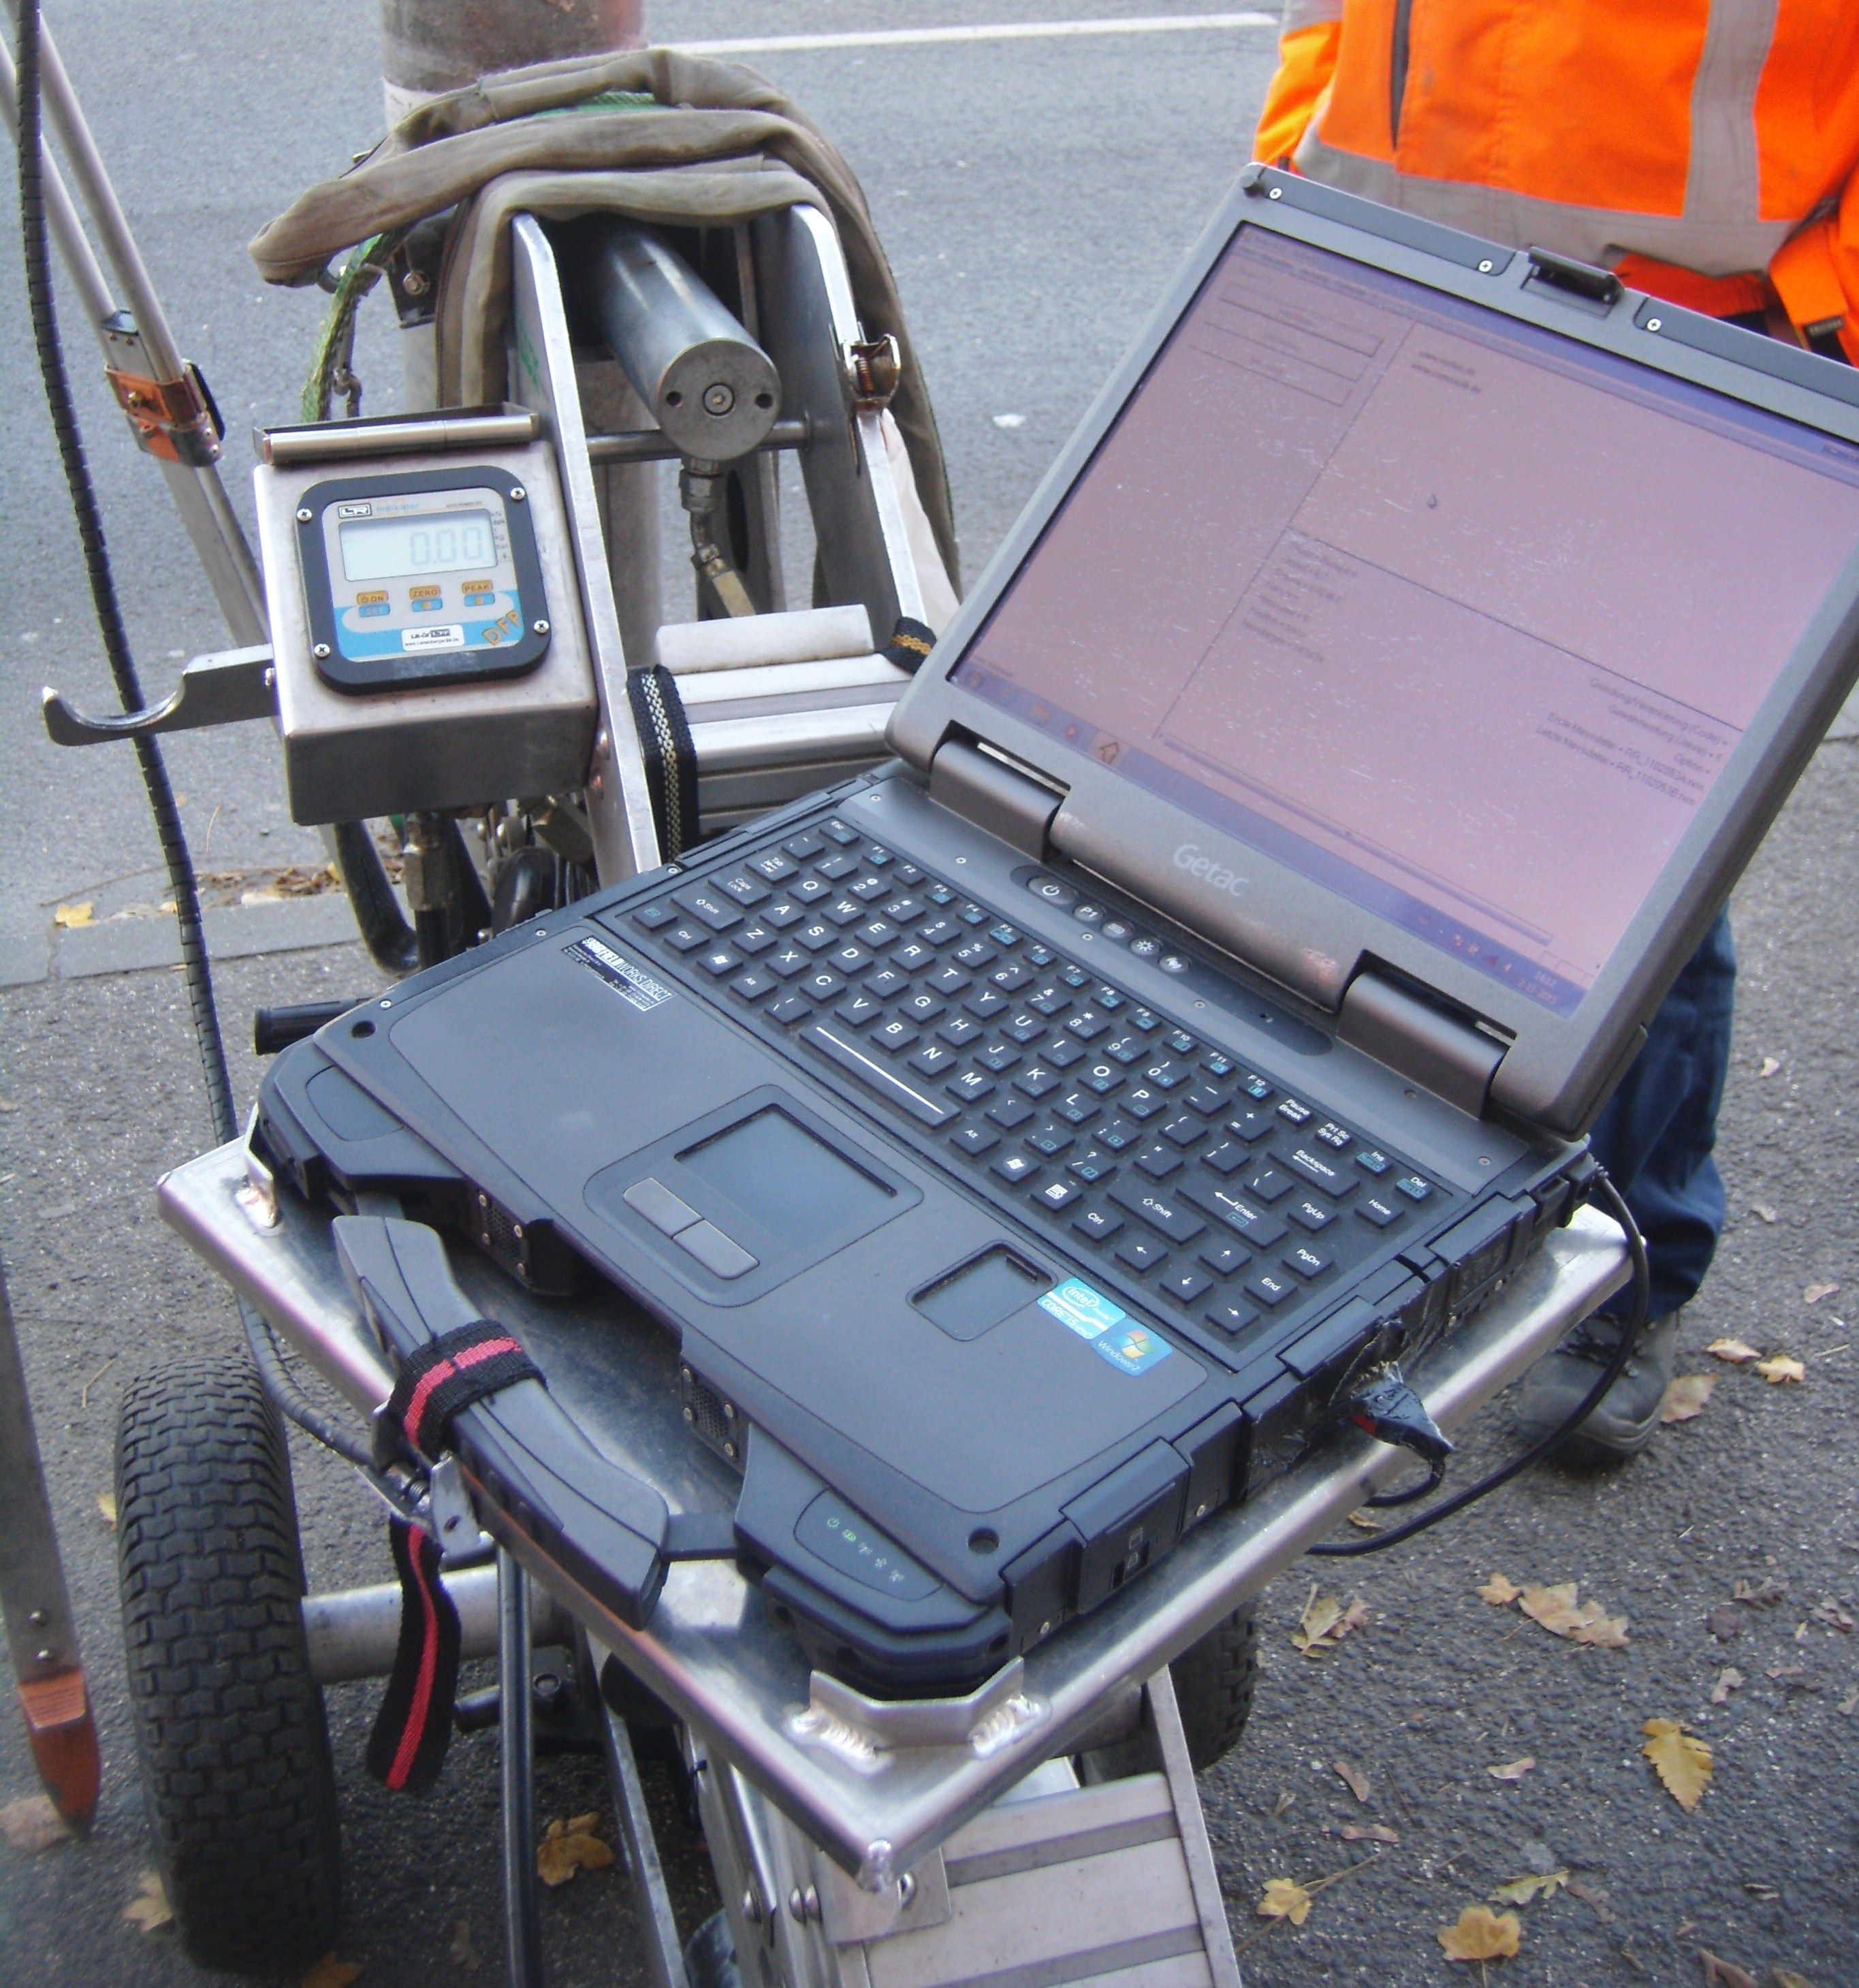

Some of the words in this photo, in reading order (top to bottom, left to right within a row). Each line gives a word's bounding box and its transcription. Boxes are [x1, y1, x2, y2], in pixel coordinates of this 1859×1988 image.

[411, 527, 482, 566] 0.00
[412, 589, 439, 597] ZERO
[464, 583, 489, 592] PEAK
[482, 610, 520, 646] DFP
[831, 820, 844, 830] Esc
[872, 846, 885, 854] F1
[903, 865, 917, 873] F2
[1173, 843, 1251, 897] Getac
[728, 882, 743, 892] Lock
[735, 878, 752, 890] Caps
[802, 880, 819, 891] Q
[853, 883, 867, 891] 2
[934, 884, 947, 893] F3
[703, 901, 719, 914] Shift
[774, 905, 790, 915] A
[837, 901, 857, 913] W
[887, 904, 901, 912] 3
[966, 903, 979, 912] F4
[1079, 906, 1098, 920] P1
[808, 926, 825, 936] S
[868, 923, 887, 933] E
[1000, 924, 1013, 933] F5
[678, 930, 692, 940] Ctrl
[746, 928, 765, 940] Z
[841, 948, 859, 959] D
[904, 945, 921, 957] R
[958, 949, 972, 957] 5
[1032, 945, 1047, 954] F6
[780, 950, 799, 963] X
[942, 967, 958, 978] T
[1066, 965, 1081, 974] F7
[815, 975, 832, 986] C
[877, 971, 895, 980] F
[995, 972, 1008, 980] 6
[744, 978, 757, 986] Alt
[642, 978, 673, 999] DIRECT
[1101, 987, 1115, 996] F8
[915, 996, 932, 1008] G
[980, 991, 996, 1002] Y
[853, 997, 869, 1008] V
[1137, 1008, 1150, 1017] F9
[950, 1019, 969, 1031] H
[1015, 1015, 1032, 1027] U
[1069, 1018, 1083, 1027] 8
[885, 1022, 903, 1033] B
[1108, 1042, 1121, 1051] 9
[922, 1046, 942, 1060] N
[961, 1072, 983, 1086] M
[1026, 1068, 1046, 1080] K
[1248, 1074, 1266, 1087] F12
[1066, 1093, 1079, 1106] L
[1132, 1089, 1149, 1099] P
[1278, 1104, 1302, 1121] Break
[1286, 1099, 1310, 1115] Pause
[965, 1129, 979, 1138] Alt
[1325, 1123, 1339, 1133] Prt
[1337, 1130, 1349, 1139] Sc
[1331, 1136, 1344, 1146] Rq
[1371, 1151, 1385, 1161] Ins
[1296, 1150, 1335, 1176] Backspace
[1410, 1176, 1427, 1188] Del
[1152, 1204, 1173, 1218] Shift
[1235, 1202, 1257, 1219] Enter
[1301, 1202, 1325, 1219] PgUp
[1368, 1199, 1391, 1215] Home
[1087, 1212, 1105, 1225] Ctrl
[1297, 1249, 1320, 1266] PgDn
[1261, 1277, 1282, 1292] End
[1069, 1287, 1095, 1306] intel
[1041, 1299, 1064, 1317] CORE
[1098, 1340, 1132, 1368] Windows
